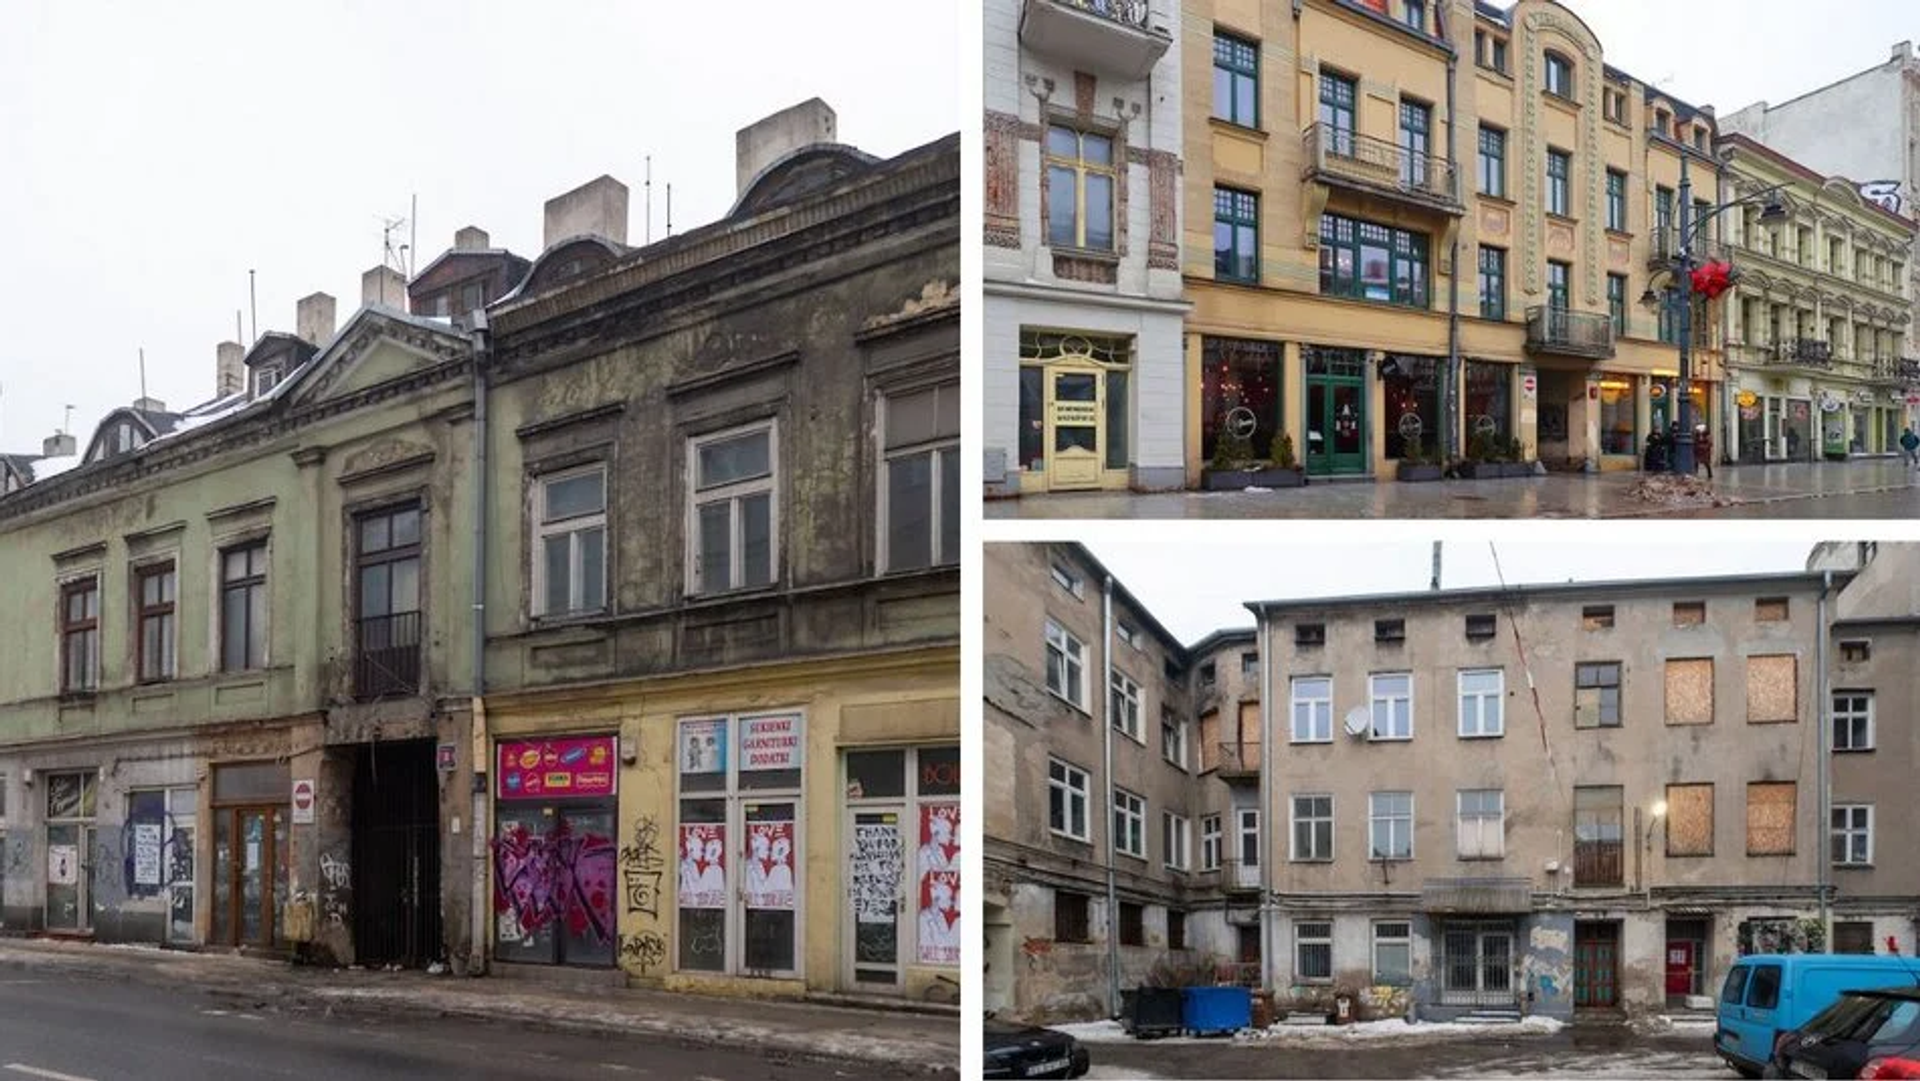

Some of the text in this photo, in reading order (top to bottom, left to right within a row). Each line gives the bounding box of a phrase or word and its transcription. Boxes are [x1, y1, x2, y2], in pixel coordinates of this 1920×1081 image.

[750, 720, 791, 733] SUKIENKI
[743, 736, 798, 750] GARNITURKI
[750, 752, 790, 765] DODATKI
[685, 825, 718, 839] LOVE
[752, 824, 786, 838] LOVE
[855, 826, 898, 838] THANK
